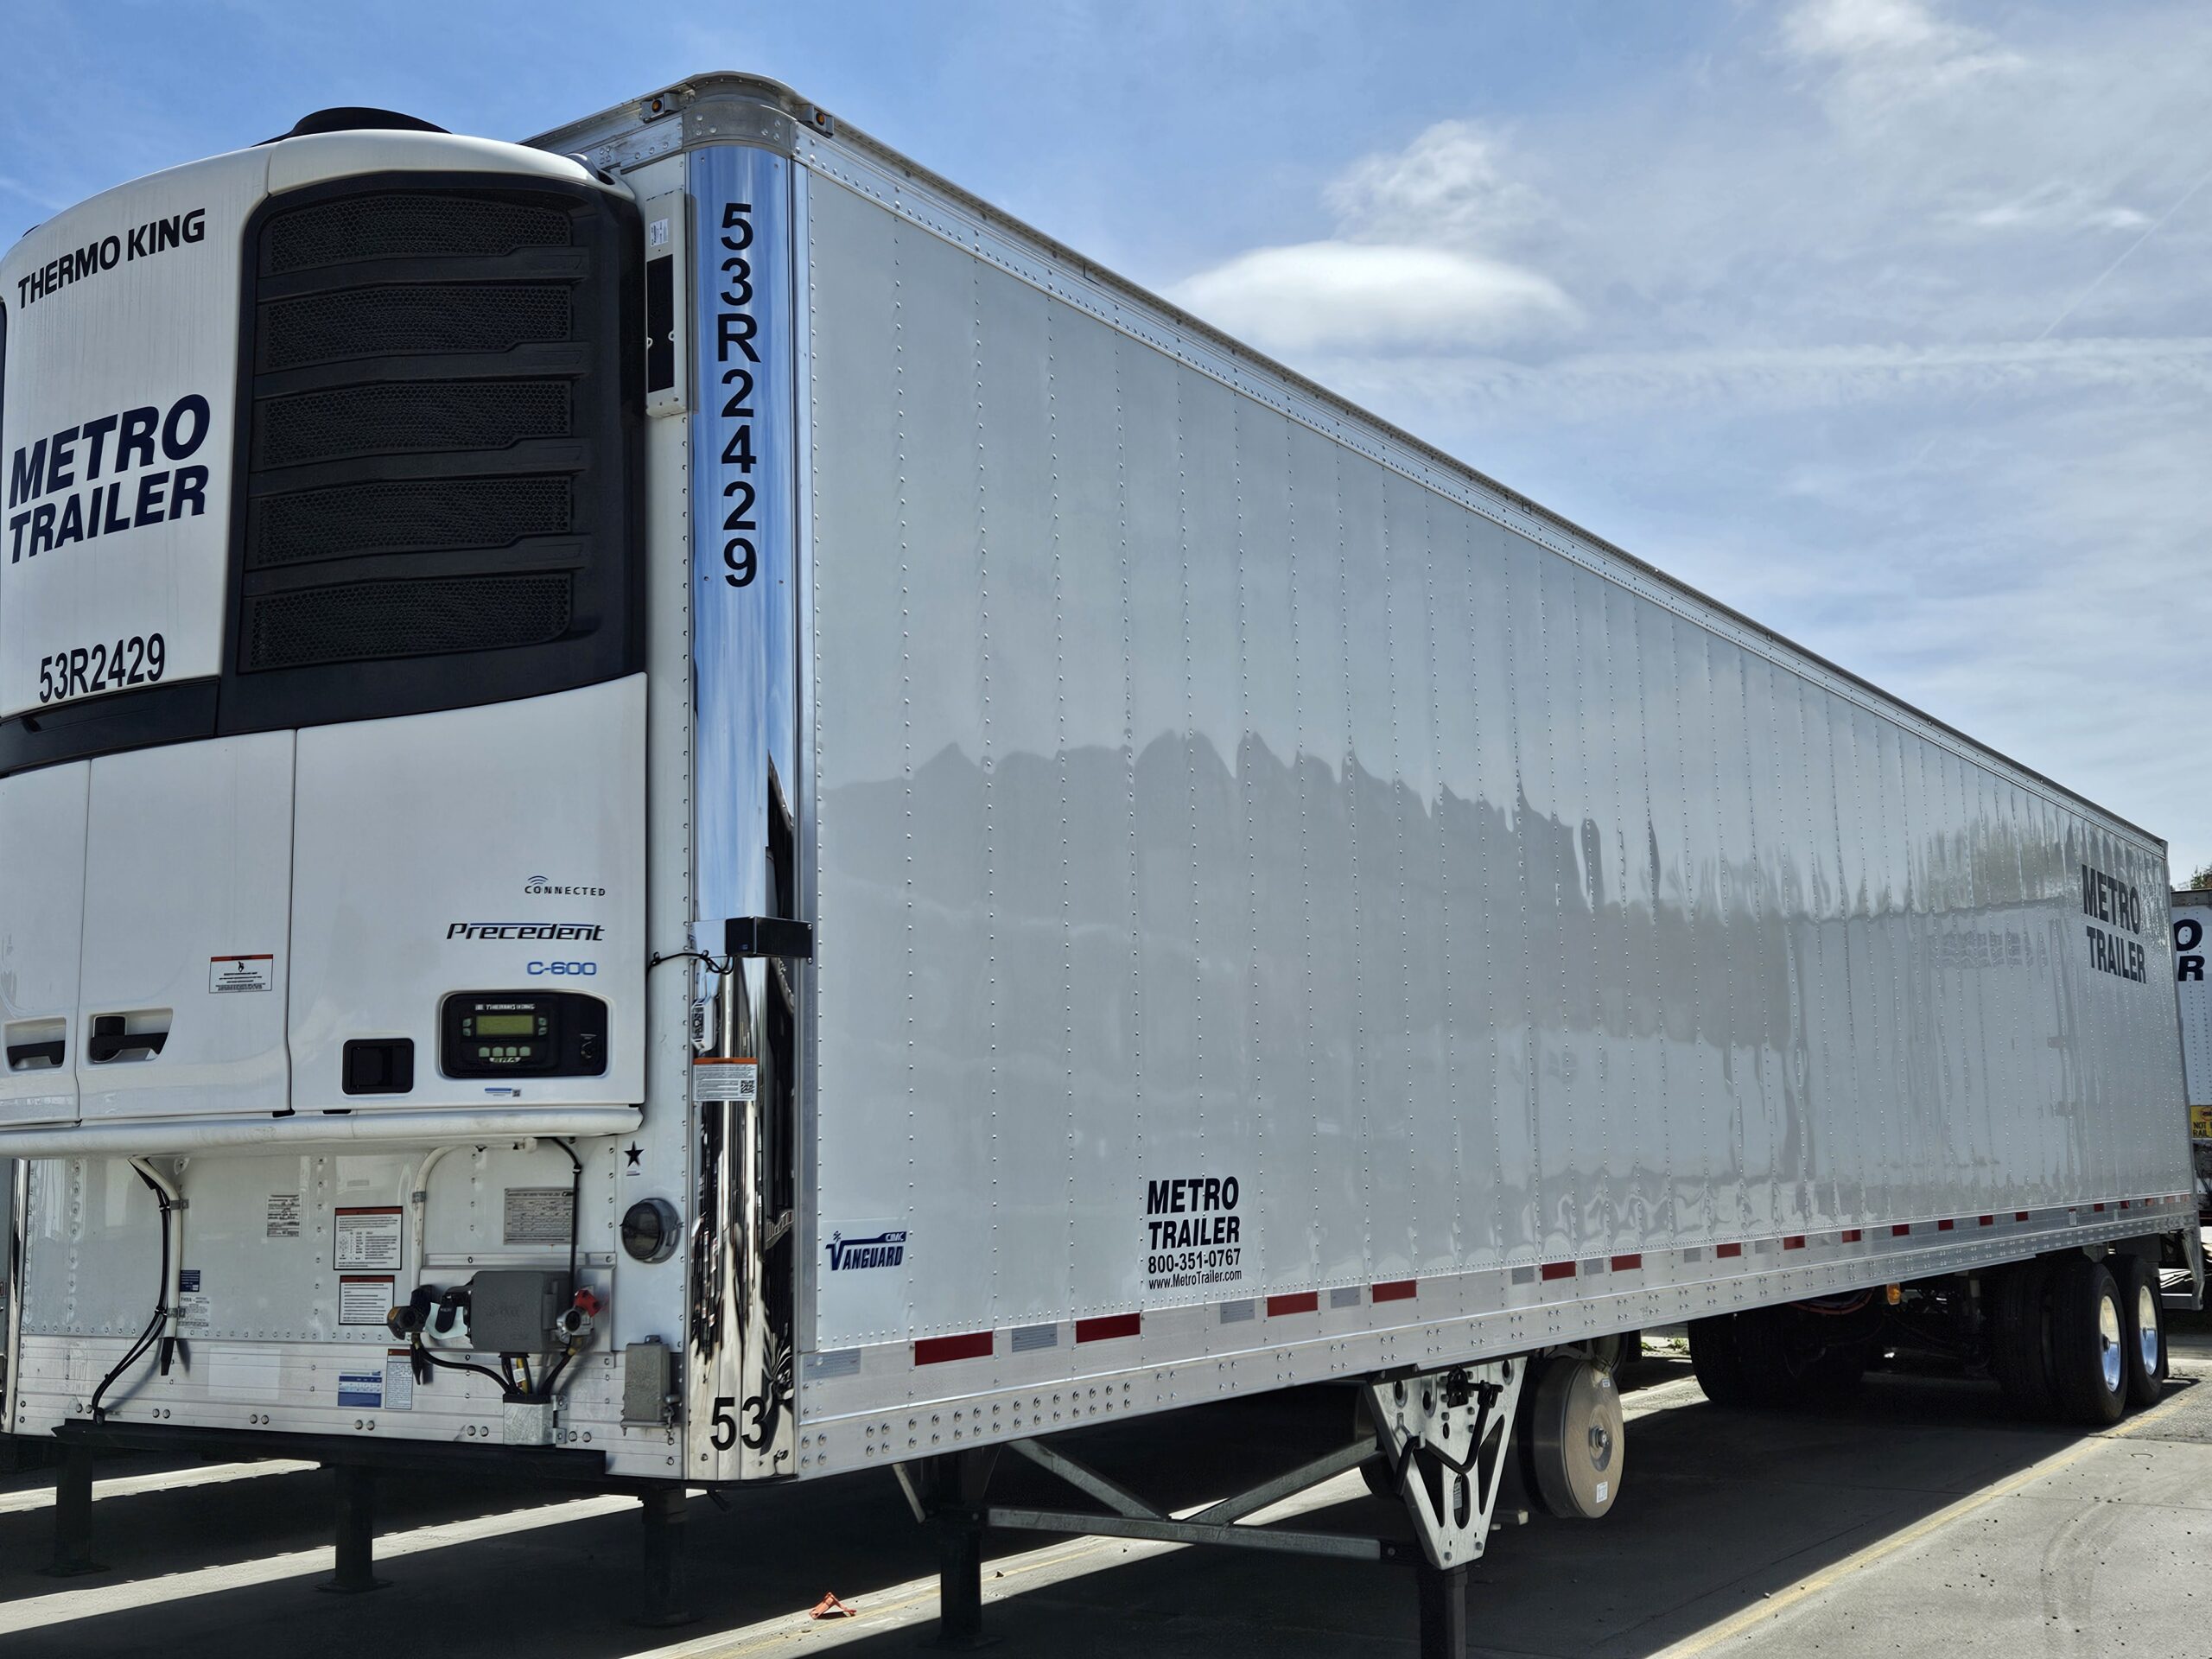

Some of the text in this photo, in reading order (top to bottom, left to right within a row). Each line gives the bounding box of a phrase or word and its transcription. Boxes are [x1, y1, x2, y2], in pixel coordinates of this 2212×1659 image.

[18, 207, 206, 309] THERMO KING
[716, 201, 762, 588] 53R2429
[9, 394, 211, 510] METRO
[10, 465, 209, 564] TRAILER
[39, 632, 166, 703] 53R2429
[524, 885, 606, 897] CONNECTED
[2082, 864, 2141, 935] METRO
[446, 922, 606, 942] Precedent
[2086, 925, 2146, 984] TRAILER
[526, 961, 598, 976] C-600
[1147, 1176, 1240, 1215] METRO
[825, 1243, 905, 1271] VANGUARD
[1148, 1216, 1241, 1250] TRAILER
[1148, 1248, 1242, 1274] 800-351-0767
[1148, 1269, 1243, 1290] www.MetroTrailer.com
[710, 1395, 769, 1452] 53
